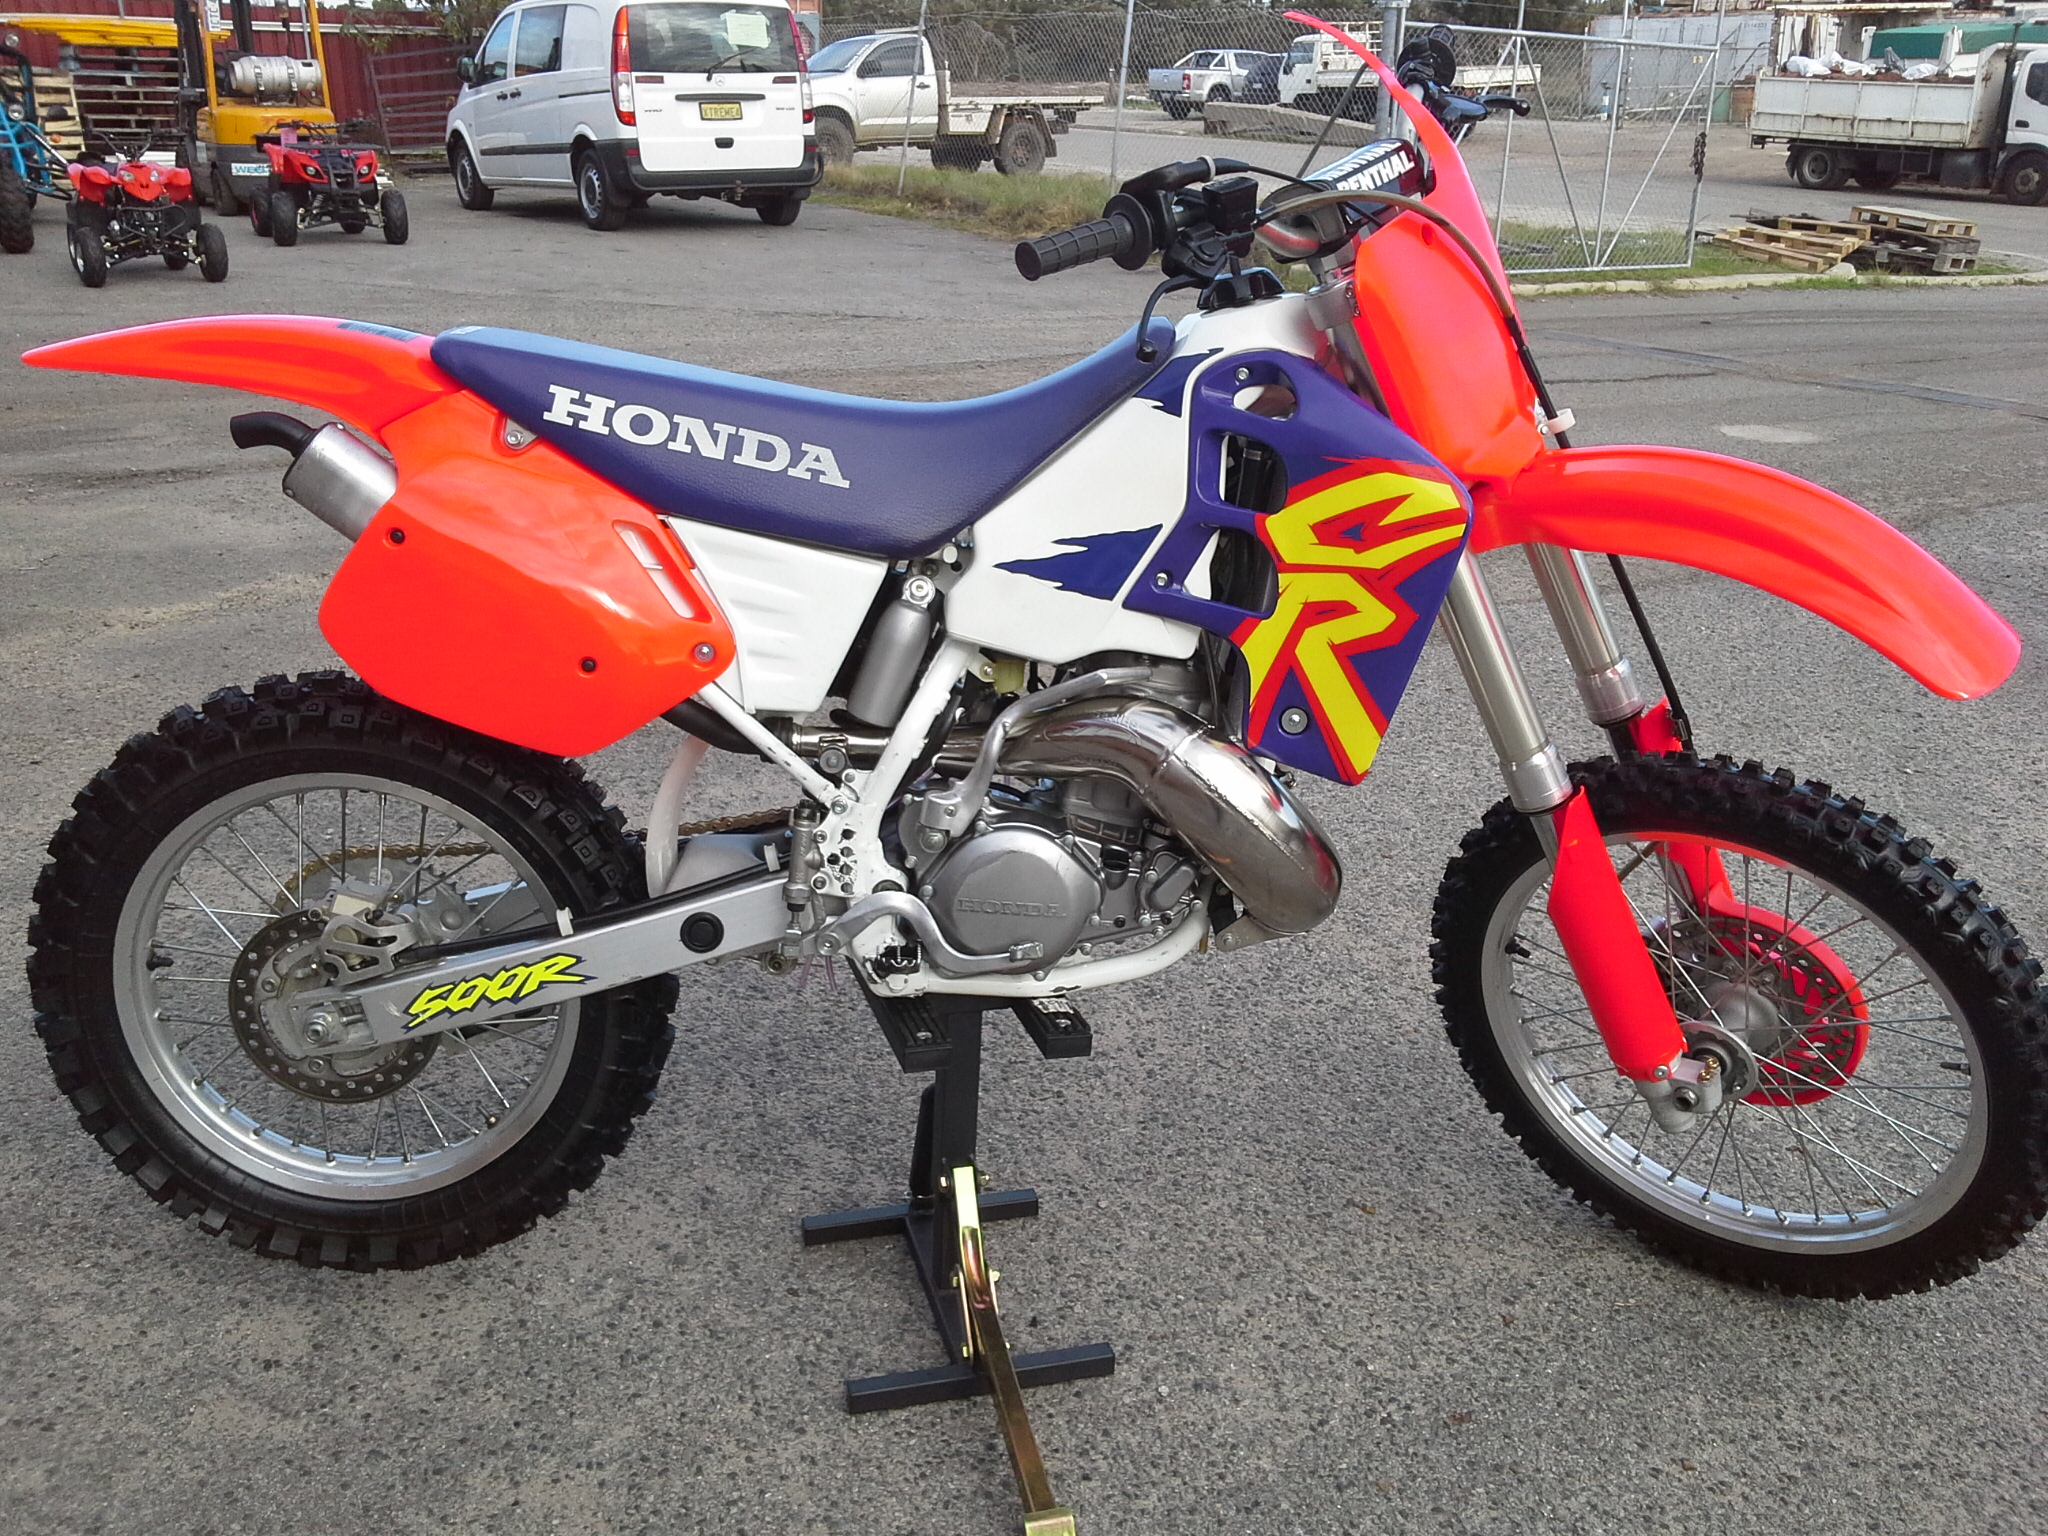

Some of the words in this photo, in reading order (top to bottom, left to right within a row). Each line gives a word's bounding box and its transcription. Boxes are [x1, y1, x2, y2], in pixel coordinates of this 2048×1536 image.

[1336, 150, 1415, 191] RENTHAL
[543, 384, 850, 488] HONDA
[1238, 471, 1468, 777] CR
[956, 897, 1067, 918] HONDA
[406, 954, 588, 1029] 500R
